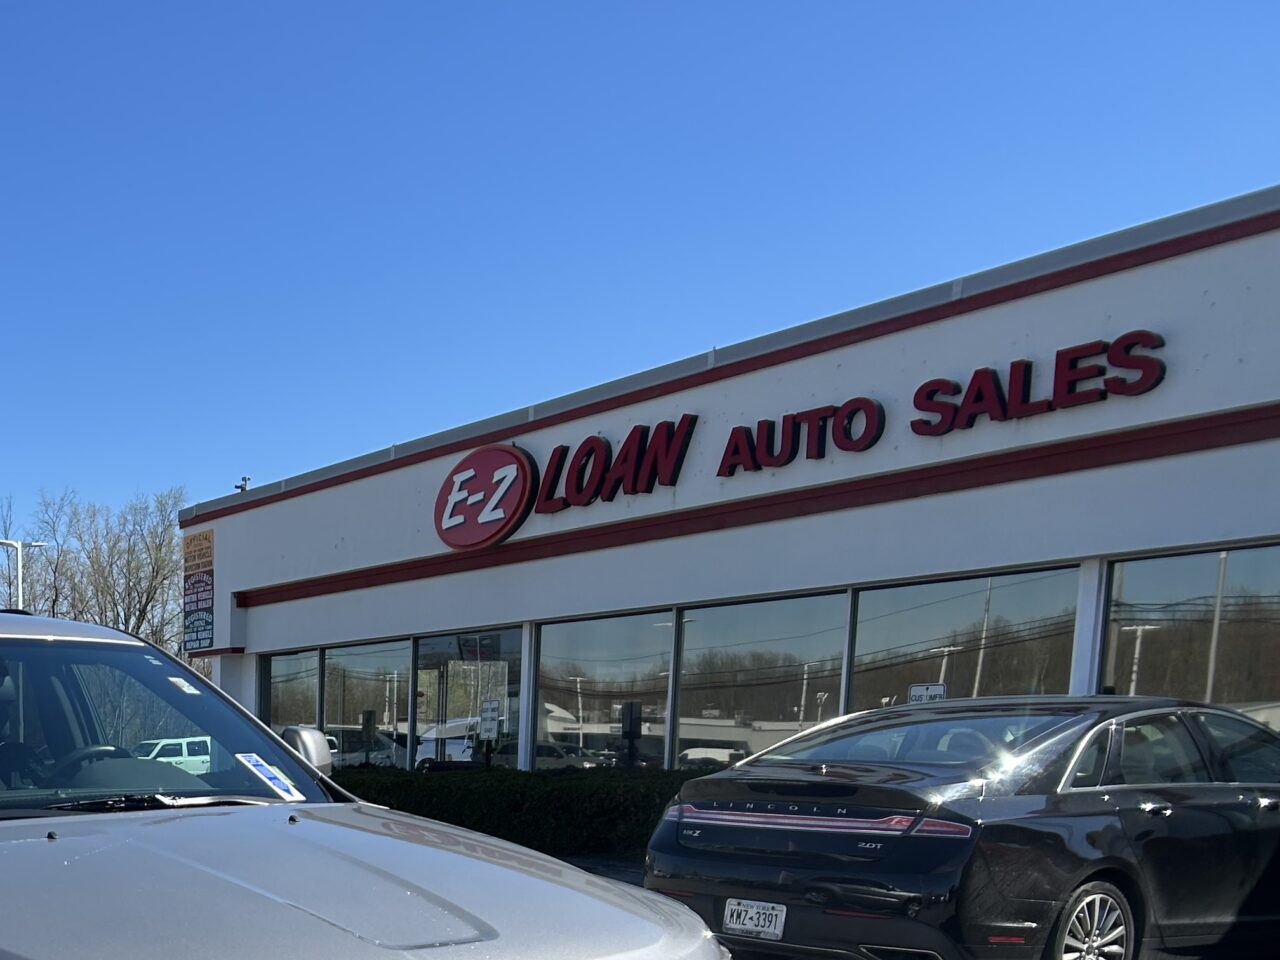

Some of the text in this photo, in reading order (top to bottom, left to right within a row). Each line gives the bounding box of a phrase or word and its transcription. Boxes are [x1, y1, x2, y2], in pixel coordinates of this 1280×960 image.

[442, 329, 1166, 530] E-Z LOAN AUTO SALES
[713, 801, 847, 815] LINCOLN
